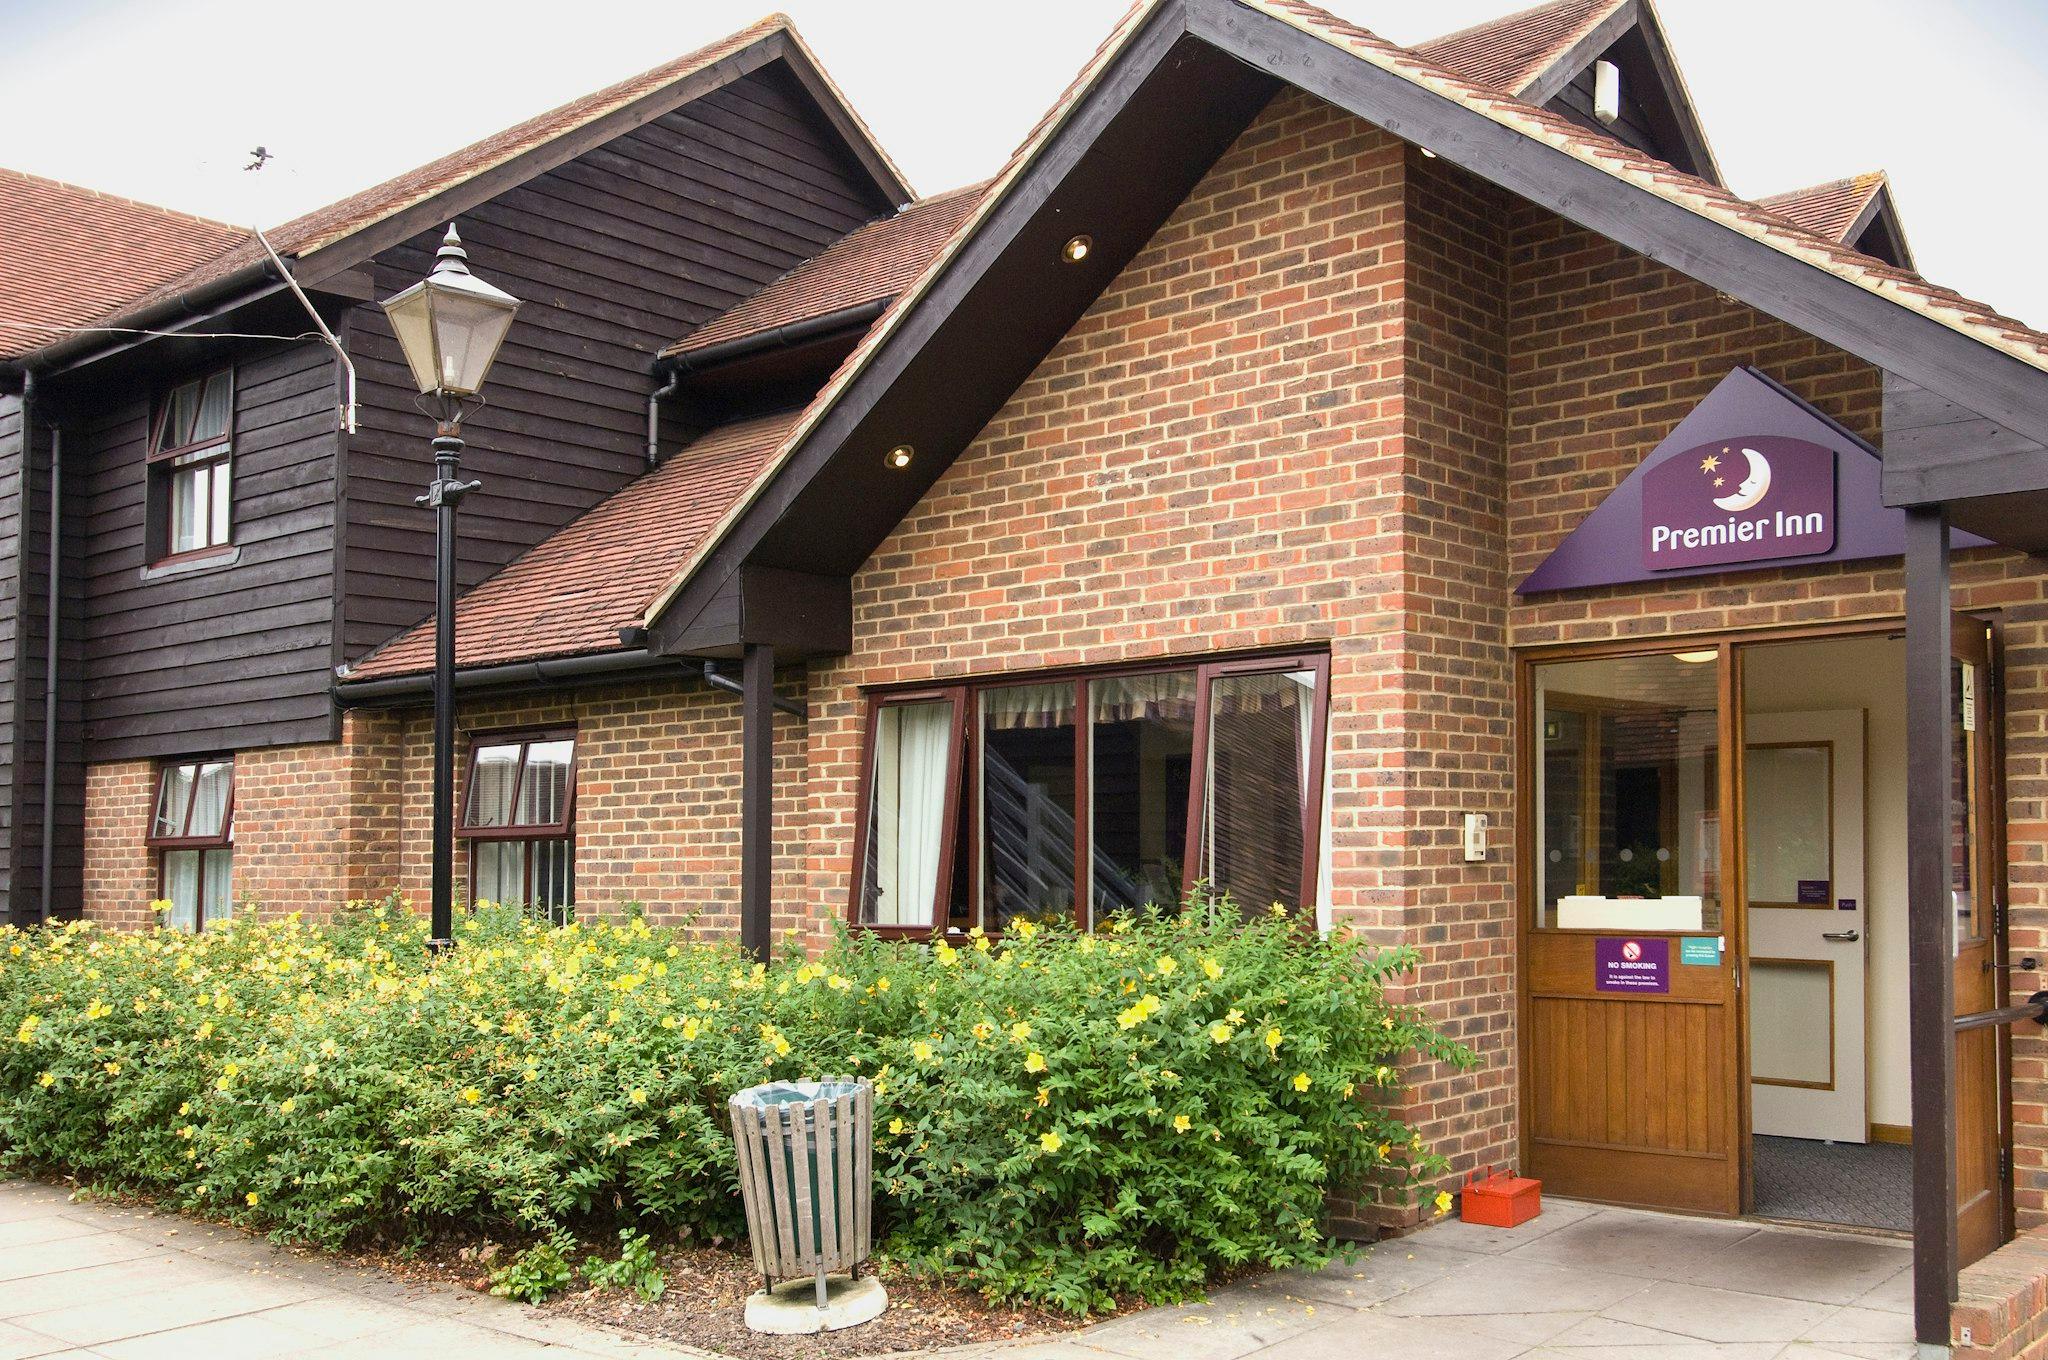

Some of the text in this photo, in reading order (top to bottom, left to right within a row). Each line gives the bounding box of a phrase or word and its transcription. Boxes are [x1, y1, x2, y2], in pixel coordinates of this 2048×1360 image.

[1652, 511, 1823, 552] Premier Inn
[1608, 961, 1657, 970] NO SMOKING
